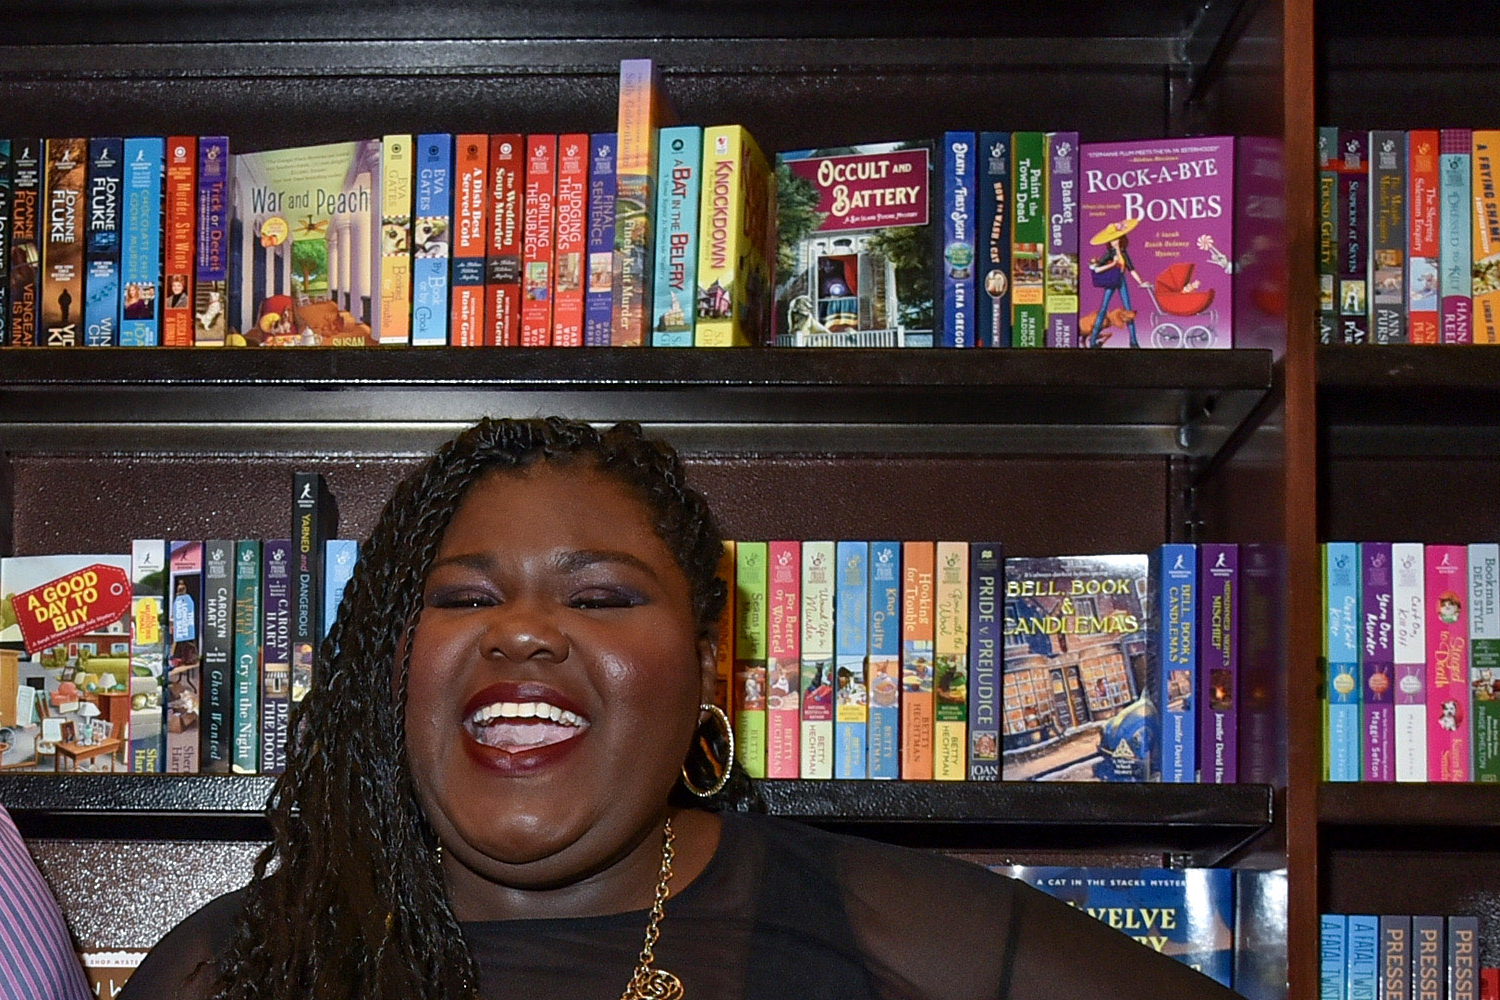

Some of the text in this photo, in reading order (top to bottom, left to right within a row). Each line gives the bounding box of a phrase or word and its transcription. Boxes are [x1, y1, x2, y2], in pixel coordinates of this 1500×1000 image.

[420, 170, 431, 210] GATES
[434, 169, 446, 194] EVA
[672, 168, 691, 199] BAT
[817, 159, 912, 188] OCCULT AND
[1016, 158, 1030, 224] Town Dead
[1029, 169, 1041, 216] Paint the
[1086, 159, 1218, 194] ROCK-A-BYE
[1479, 157, 1494, 198] FRYING
[93, 178, 106, 230] FLUKE
[105, 177, 120, 230] JOANNE
[252, 185, 368, 216] War and Peach
[461, 173, 472, 247] Served Cold
[472, 168, 482, 238] A Dish Best
[493, 168, 504, 250] Soup Murder
[504, 172, 516, 246] The Wedding
[526, 182, 538, 259] THE SUBJECT
[539, 194, 550, 247] GRILLING
[558, 177, 571, 250] THE BOOKS
[570, 184, 582, 242] FUDGING
[671, 212, 681, 232] THE
[672, 201, 681, 209] IN
[710, 161, 734, 268] KNOCKDOWN
[831, 184, 921, 217] BATTERY
[1062, 180, 1075, 224] Basket
[1122, 192, 1222, 222] BONES
[1486, 202, 1500, 243] SHAME
[1052, 214, 1062, 246] Case
[621, 208, 636, 330] A Finely Knit Murder
[668, 234, 689, 292] BELFRY
[26, 570, 98, 610] A GOOD
[299, 514, 311, 637] YARNED and DANGEROUS
[1071, 578, 1131, 596] BOOK
[34, 586, 98, 623] DAY TO
[52, 605, 88, 632] BUY
[206, 600, 216, 626] HART
[216, 587, 227, 638] CAROLYN
[906, 567, 918, 631] for Trouble
[919, 573, 931, 624] Hooking
[1060, 597, 1074, 615] &
[1003, 614, 1139, 635] CANDLEMAS
[1366, 613, 1377, 656] Murder
[1376, 594, 1390, 649] Yarn Over
[977, 576, 994, 725] PRIDE v PREJUDICE
[236, 654, 252, 759] Cry in the Night
[1036, 880, 1043, 888] A
[1048, 879, 1066, 887] CAT
[1110, 880, 1146, 888] STACKS
